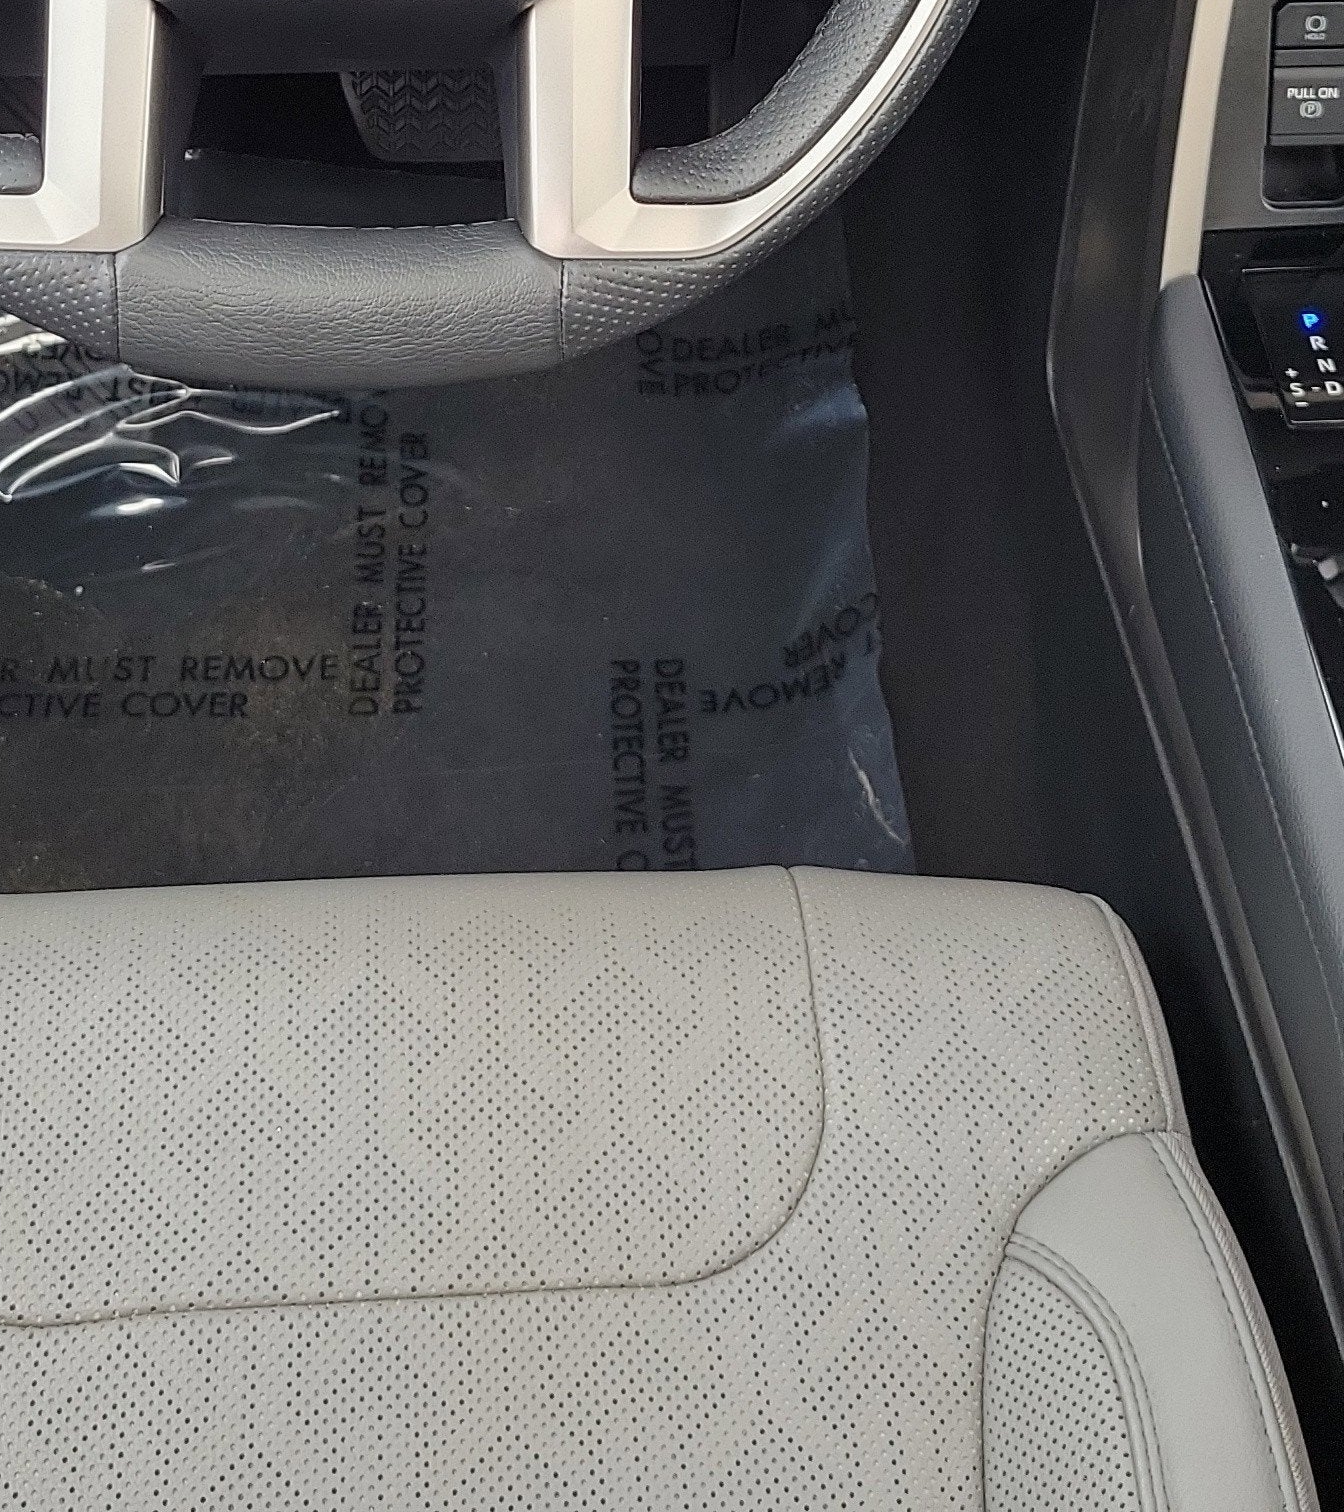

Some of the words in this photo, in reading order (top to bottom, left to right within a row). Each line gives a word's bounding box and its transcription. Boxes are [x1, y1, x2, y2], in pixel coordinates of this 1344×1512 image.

[1287, 87, 1316, 100] PULL
[1317, 87, 1339, 99] ON
[1301, 313, 1320, 329] P
[1309, 335, 1329, 351] R
[1316, 358, 1337, 373] N
[1289, 382, 1307, 398] S
[1324, 380, 1344, 396] D
[399, 430, 430, 531] COVER
[357, 506, 388, 584] MUST
[392, 543, 429, 715] PROTECTIVE
[47, 656, 157, 682] MUST
[178, 654, 341, 682] REMOVE
[348, 603, 384, 716] DEALER
[121, 691, 251, 719] COVER
[654, 657, 692, 763] DEALER
[609, 658, 649, 835] PROTECTIVE
